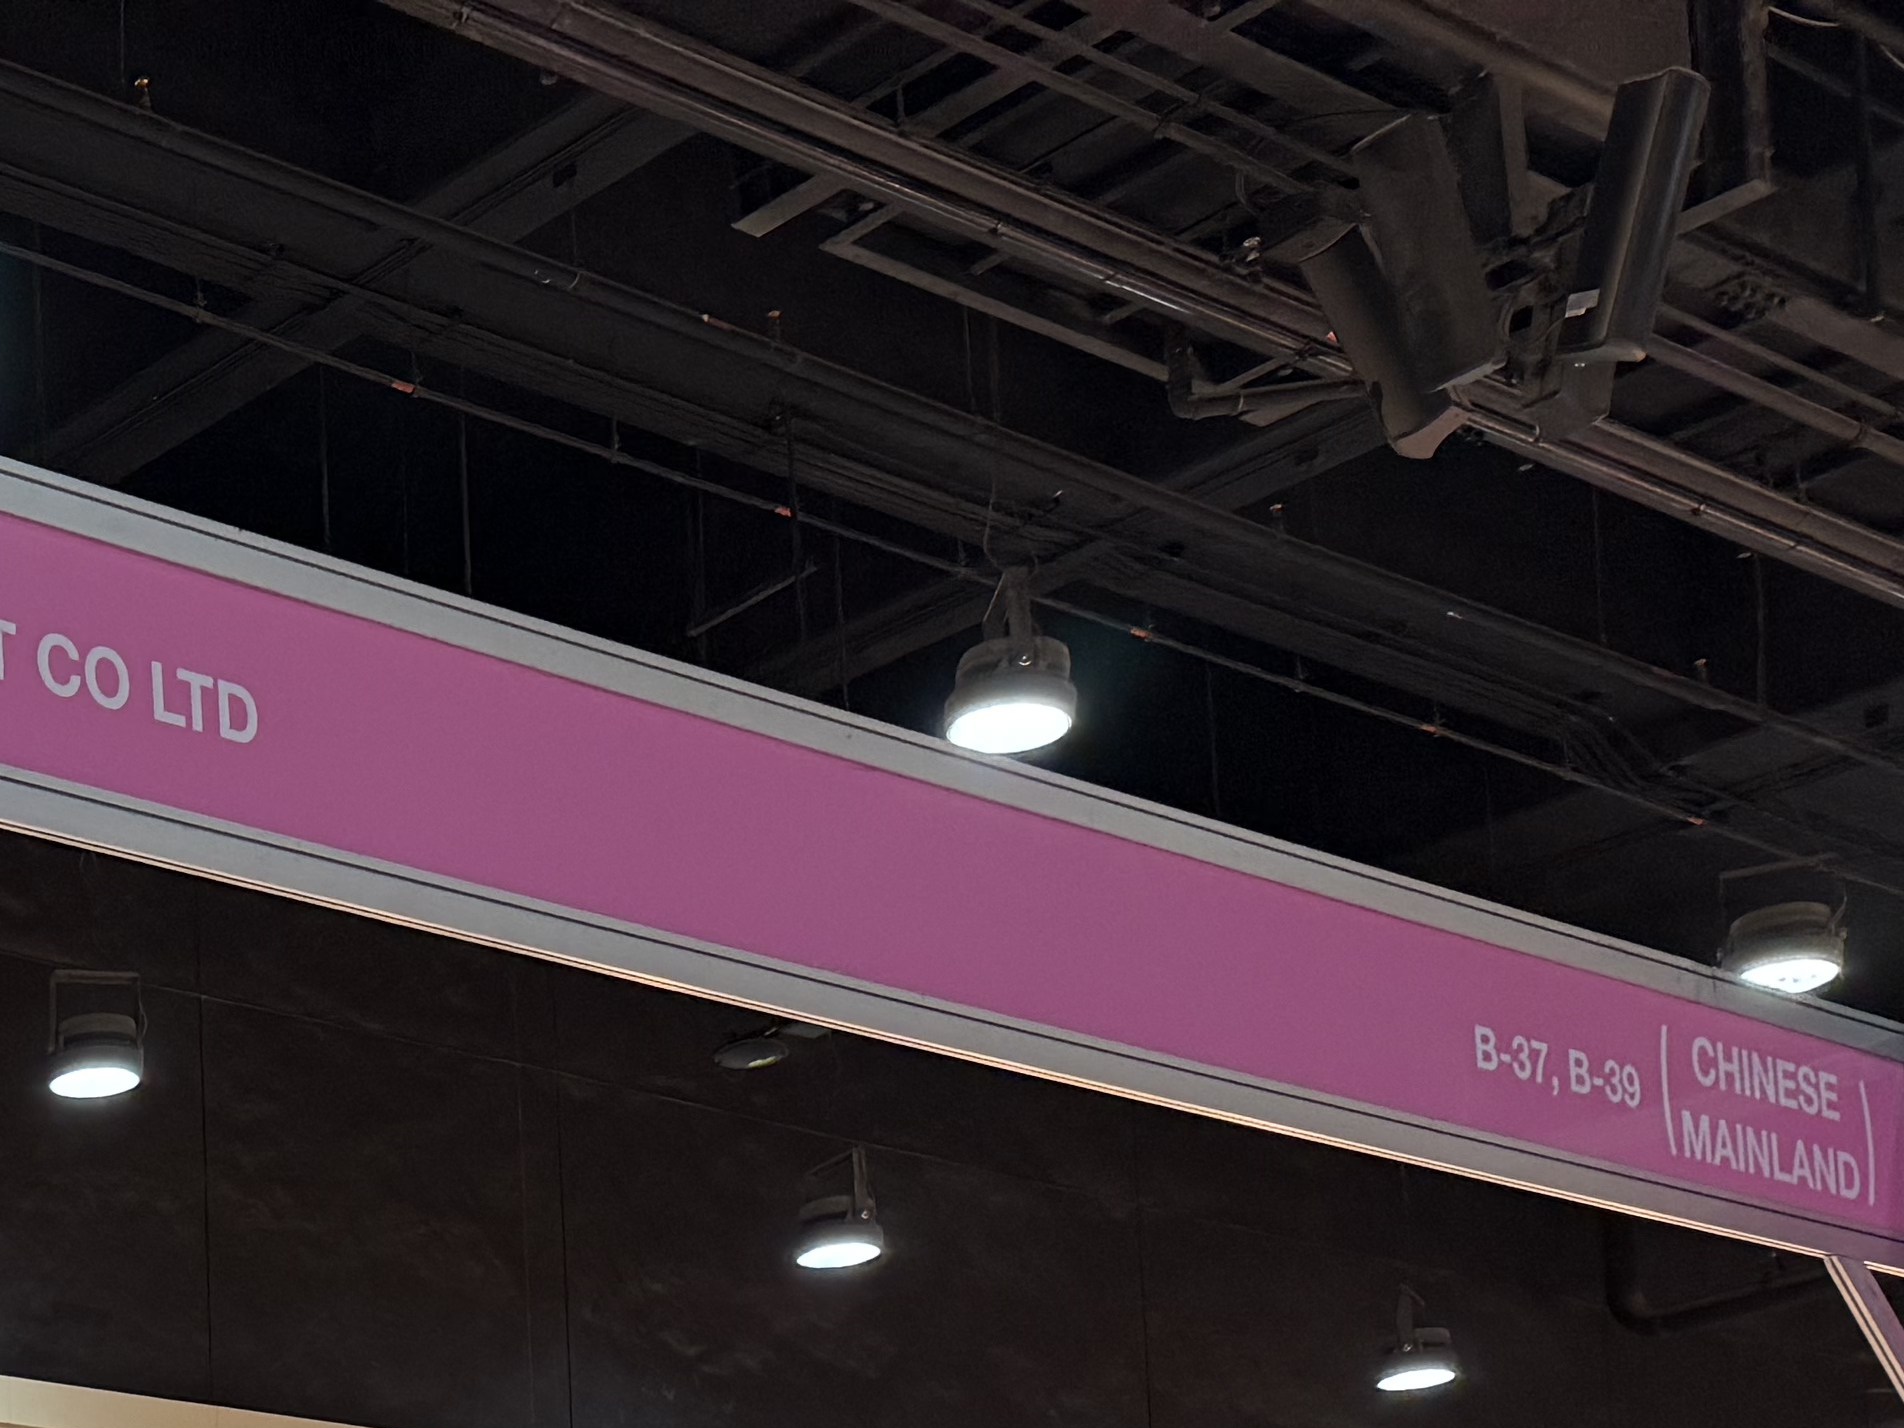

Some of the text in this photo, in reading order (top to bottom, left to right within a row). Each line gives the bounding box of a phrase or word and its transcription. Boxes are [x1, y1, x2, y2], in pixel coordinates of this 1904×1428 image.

[37, 633, 130, 710] CO
[149, 663, 259, 745] LTD
[1475, 1024, 1641, 1109] B-37, B-39
[1692, 1037, 1840, 1122] CHINESE
[1681, 1110, 1861, 1200] MAINLAND
